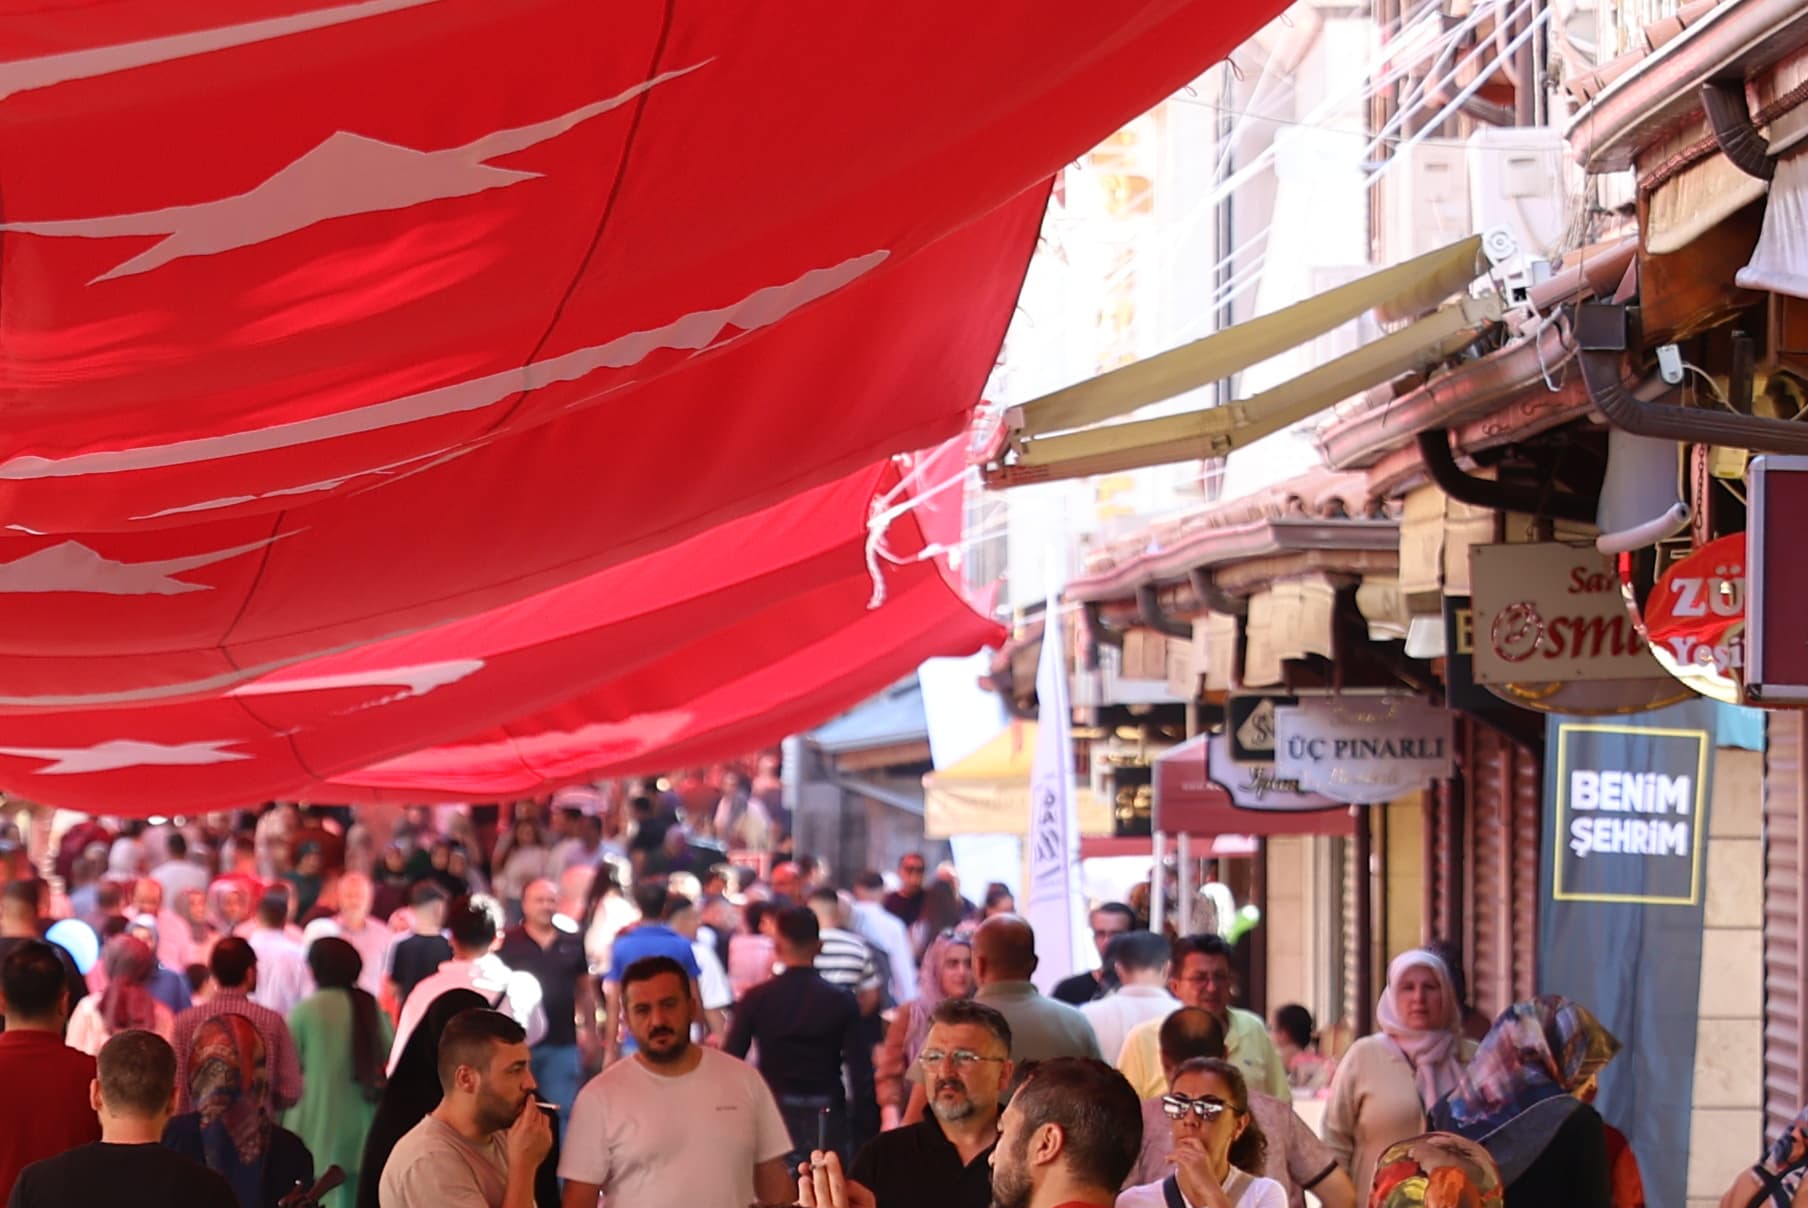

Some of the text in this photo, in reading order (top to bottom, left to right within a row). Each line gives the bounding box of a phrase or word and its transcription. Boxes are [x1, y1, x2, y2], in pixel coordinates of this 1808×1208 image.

[1671, 565, 1744, 617] ZÜ
[1288, 735, 1445, 762] ÜÇ PINARLI
[1571, 770, 1690, 815] BENİM
[1569, 816, 1688, 858] ŞEHRİM
